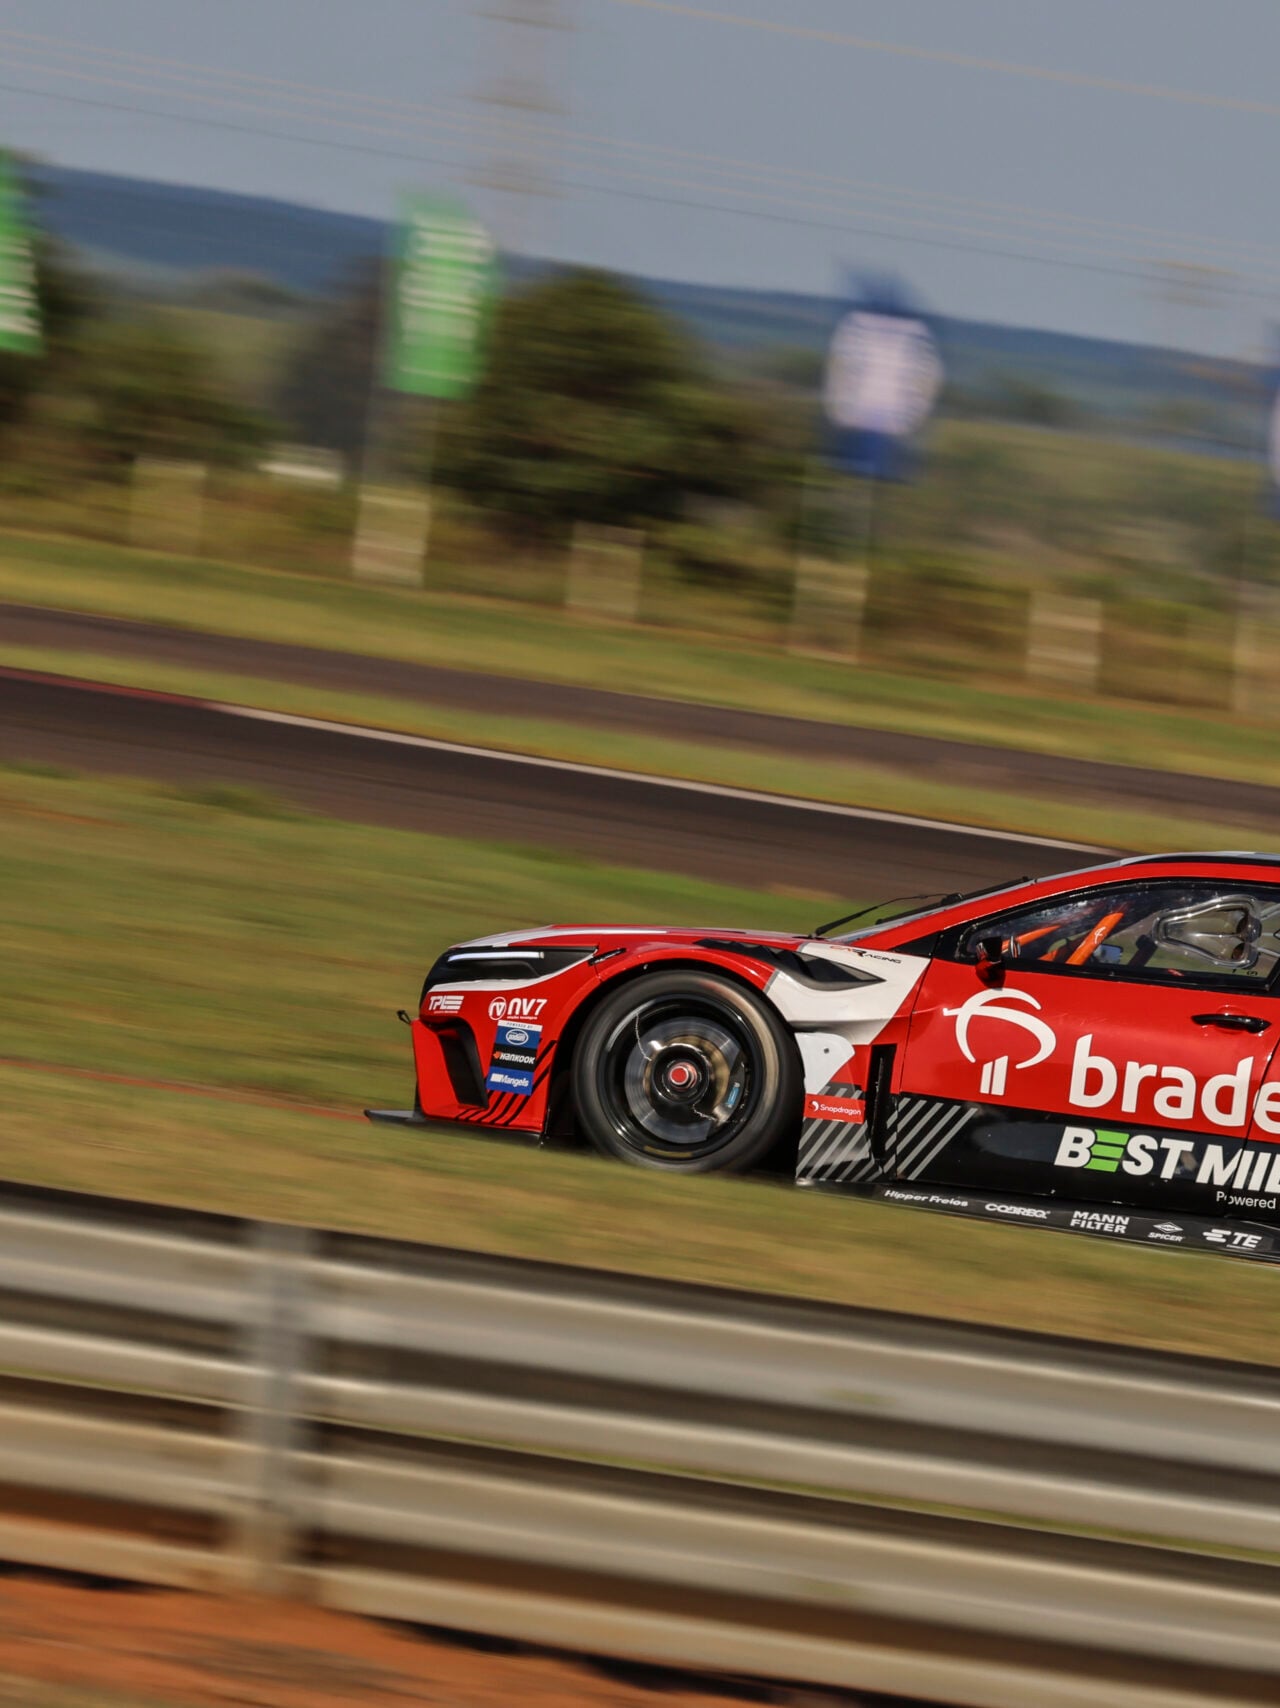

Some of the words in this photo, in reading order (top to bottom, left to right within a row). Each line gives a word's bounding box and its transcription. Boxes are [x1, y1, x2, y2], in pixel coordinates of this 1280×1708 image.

[500, 1073, 530, 1088] Mangels
[820, 1103, 862, 1116] Snapdragon
[1054, 1126, 1195, 1180] BEST
[884, 1189, 928, 1204] Hipper
[929, 1195, 969, 1207] Freios
[1216, 1191, 1276, 1211] Powered
[1070, 1218, 1127, 1234] FILTER
[1072, 1210, 1130, 1226] MANN
[1148, 1231, 1184, 1243] SPICER
